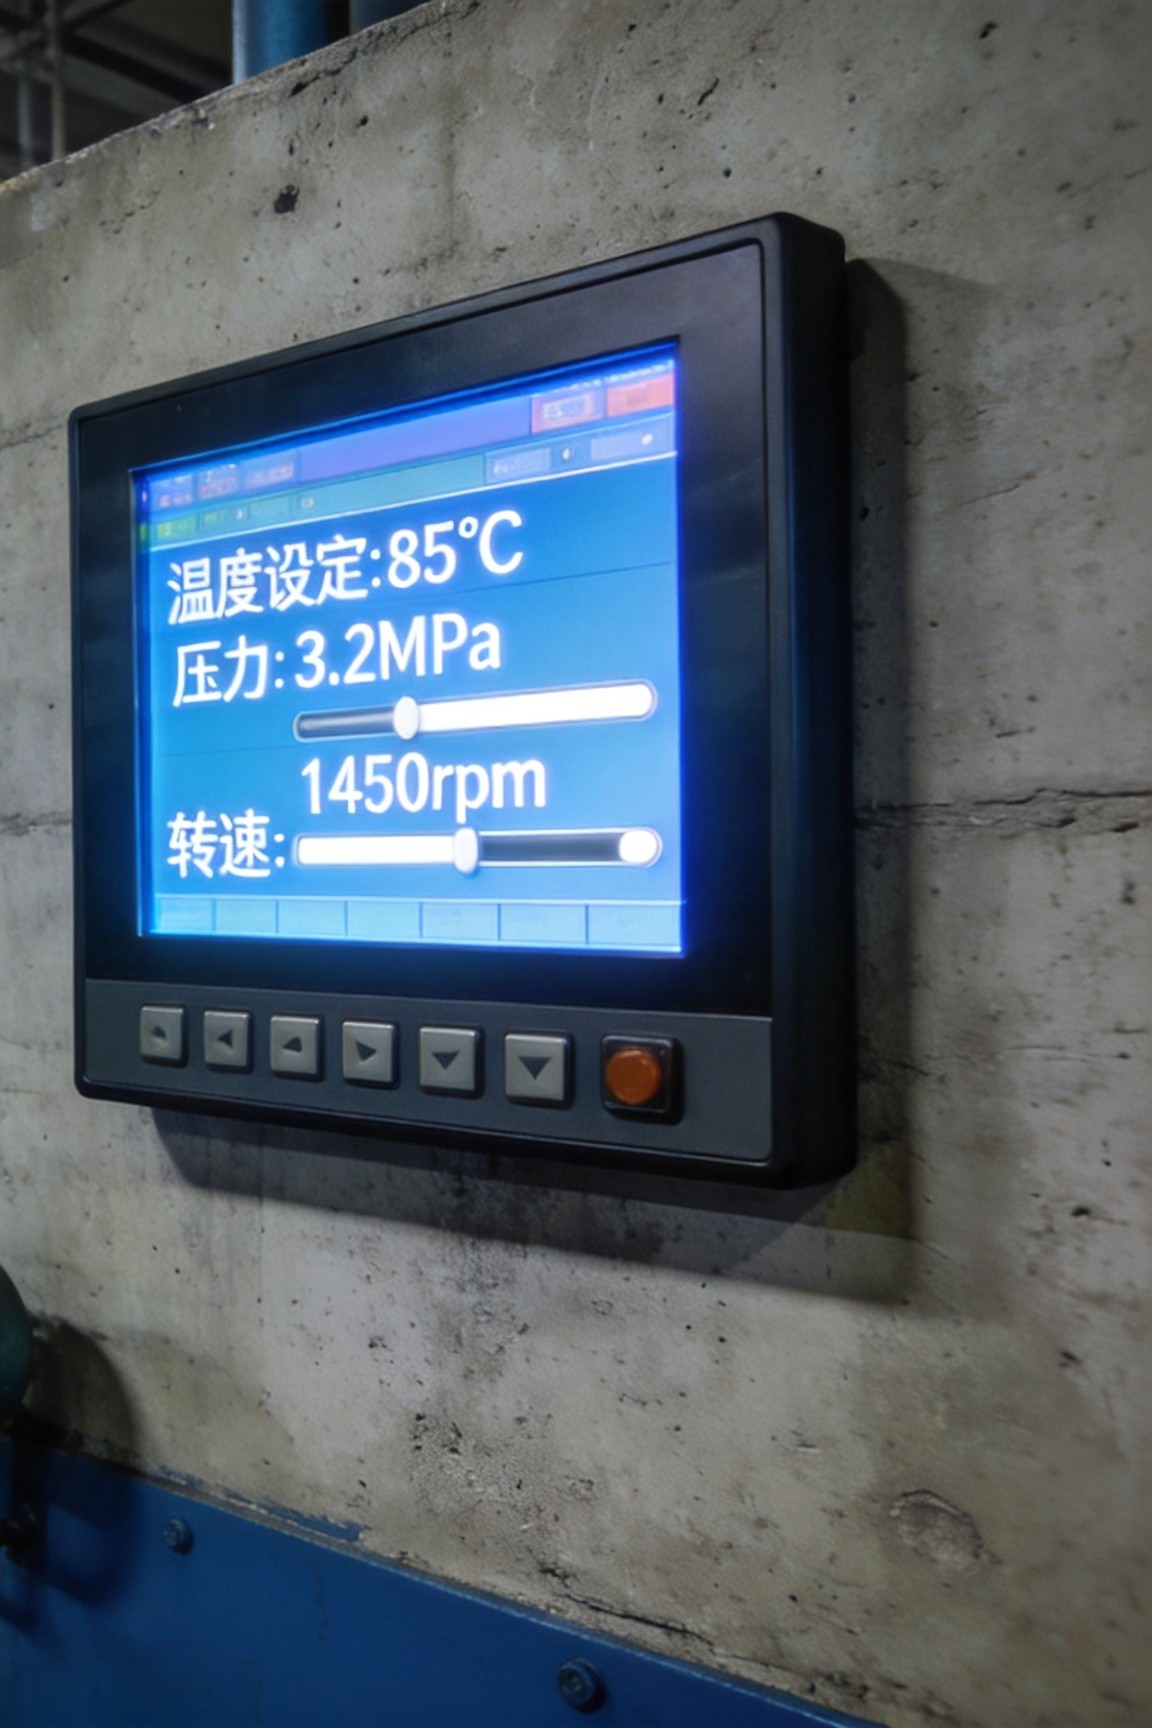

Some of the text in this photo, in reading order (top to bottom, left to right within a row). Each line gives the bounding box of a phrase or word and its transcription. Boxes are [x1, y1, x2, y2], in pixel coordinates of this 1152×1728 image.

[172, 612, 501, 707] 压力:3.2MPa
[301, 752, 547, 824] 1450rpm
[167, 809, 286, 878] 转速:
